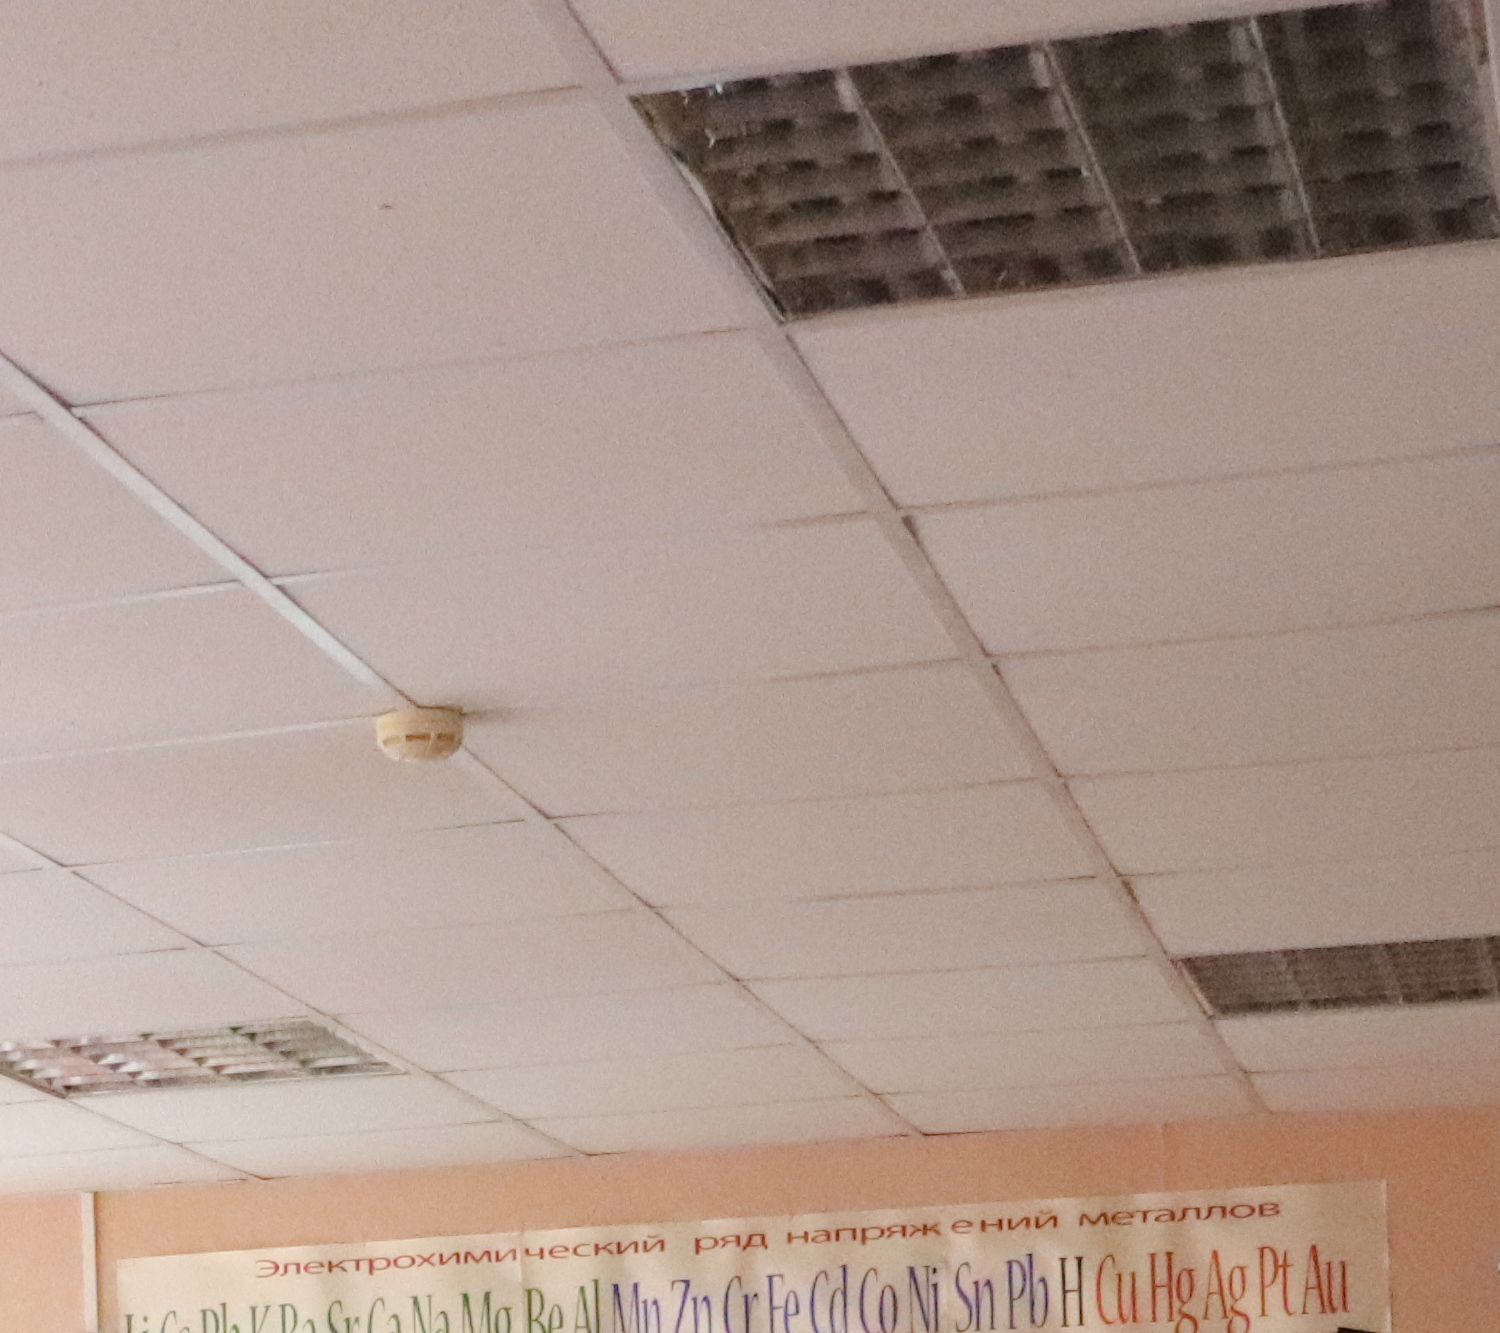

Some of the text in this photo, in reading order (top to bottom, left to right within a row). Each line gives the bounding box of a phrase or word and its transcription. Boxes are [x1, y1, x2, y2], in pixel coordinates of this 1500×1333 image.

[255, 1234, 667, 1279] Электрохимический
[693, 1232, 769, 1256] ряд
[1078, 1202, 1282, 1227] металлов
[954, 1261, 996, 1333] Sn
[1005, 1253, 1049, 1329] Pb
[1059, 1256, 1084, 1327] H
[1095, 1254, 1139, 1325] Cu
[1257, 1246, 1296, 1318] Pt
[1302, 1244, 1350, 1314] Au
